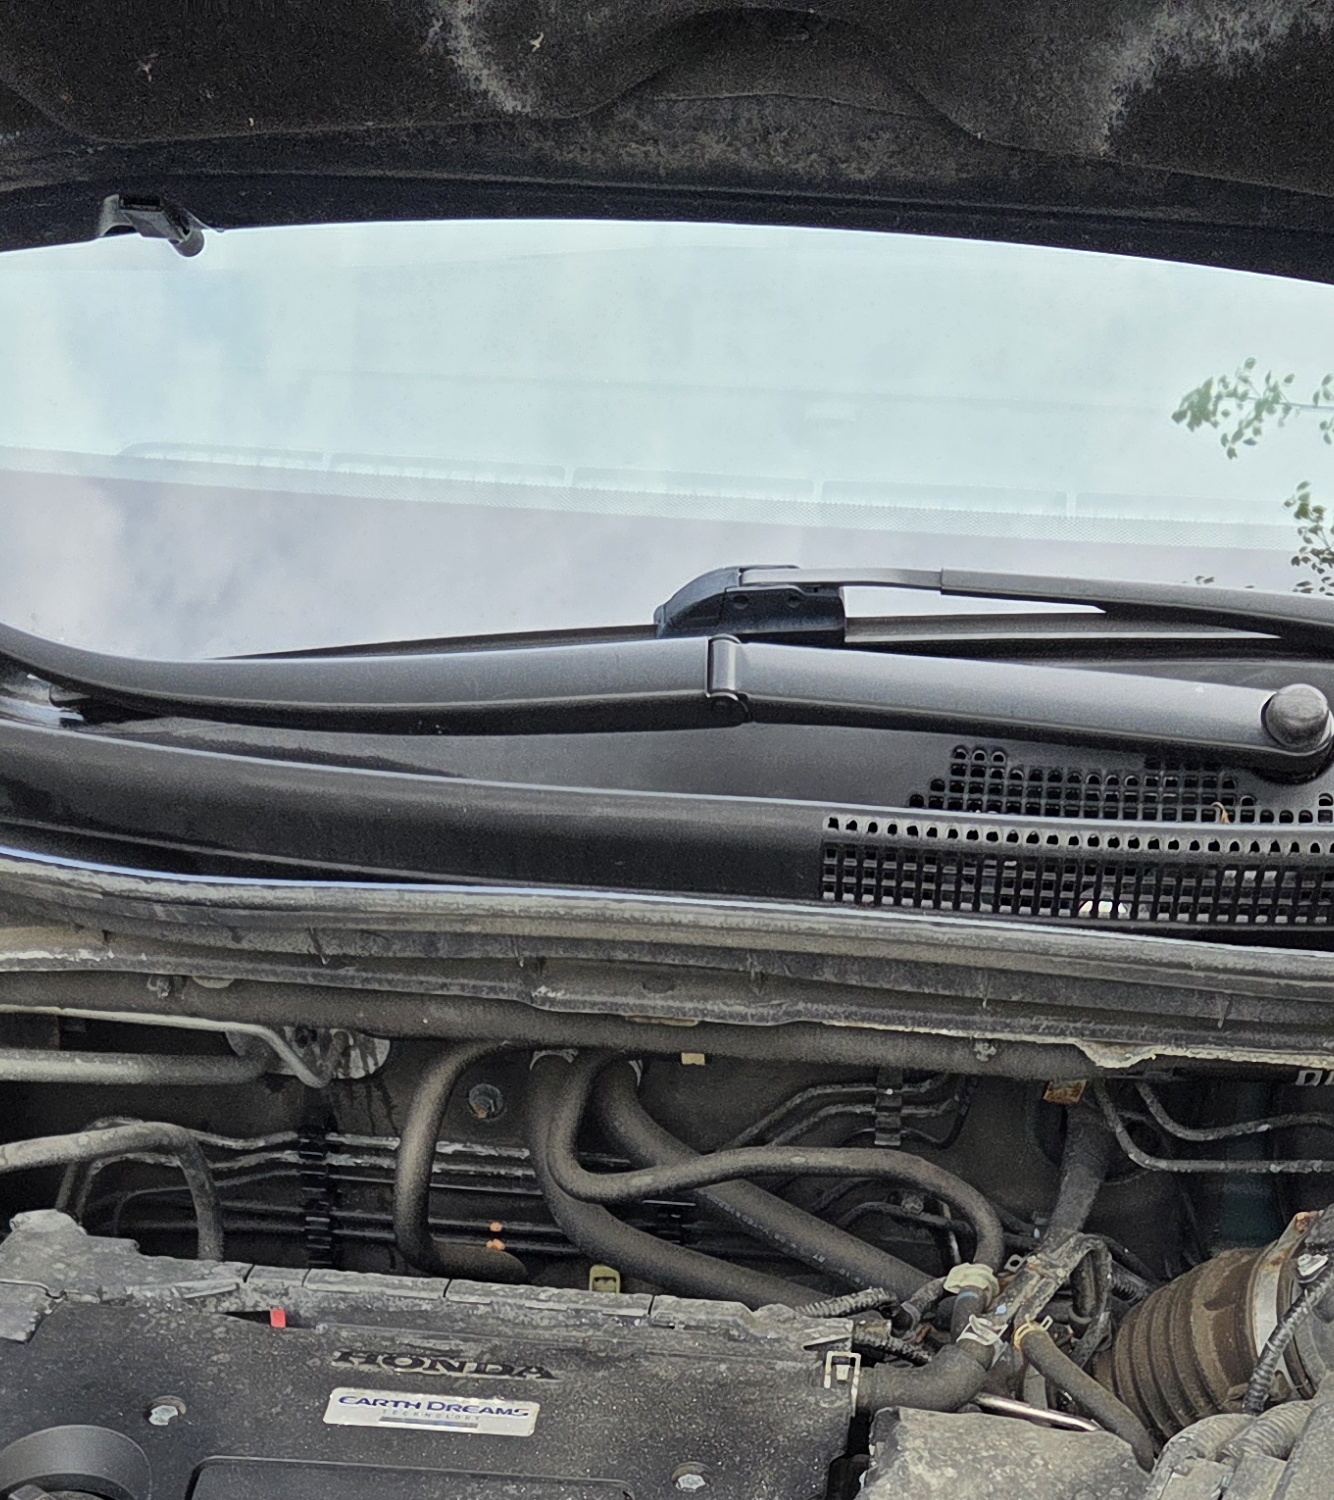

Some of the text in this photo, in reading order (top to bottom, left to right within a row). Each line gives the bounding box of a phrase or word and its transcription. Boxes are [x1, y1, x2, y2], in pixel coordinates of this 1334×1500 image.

[332, 1350, 557, 1380] HONDA
[338, 1395, 530, 1417] EARTH DREAMS
